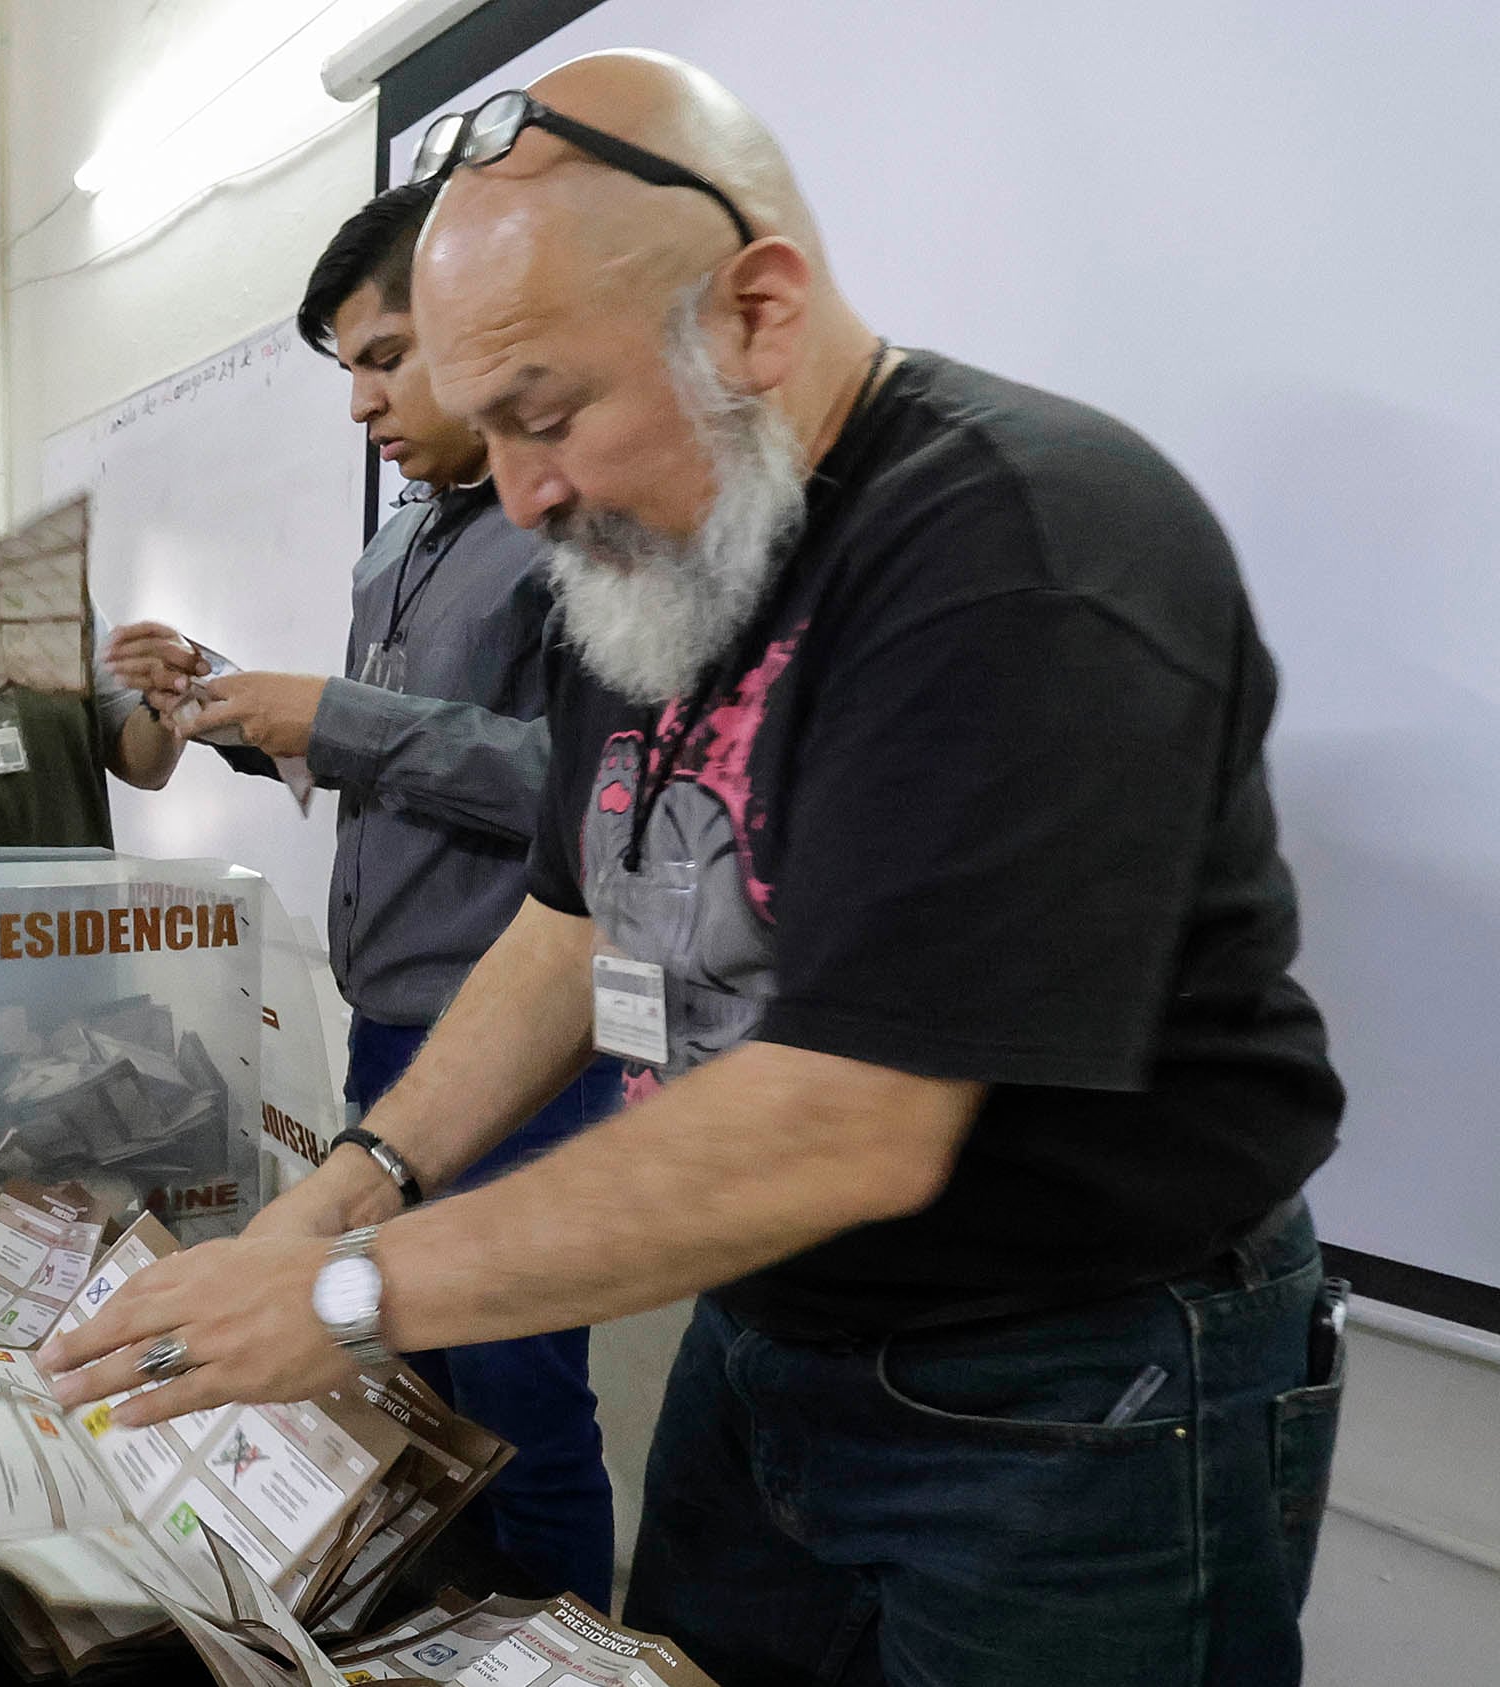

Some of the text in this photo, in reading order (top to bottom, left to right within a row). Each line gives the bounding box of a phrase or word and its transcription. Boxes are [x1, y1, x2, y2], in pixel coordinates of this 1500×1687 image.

[554, 1608, 640, 1657] PRESIDENCIA
[569, 1606, 609, 1634] ELECTORAL
[608, 1631, 640, 1646] FEDERAL
